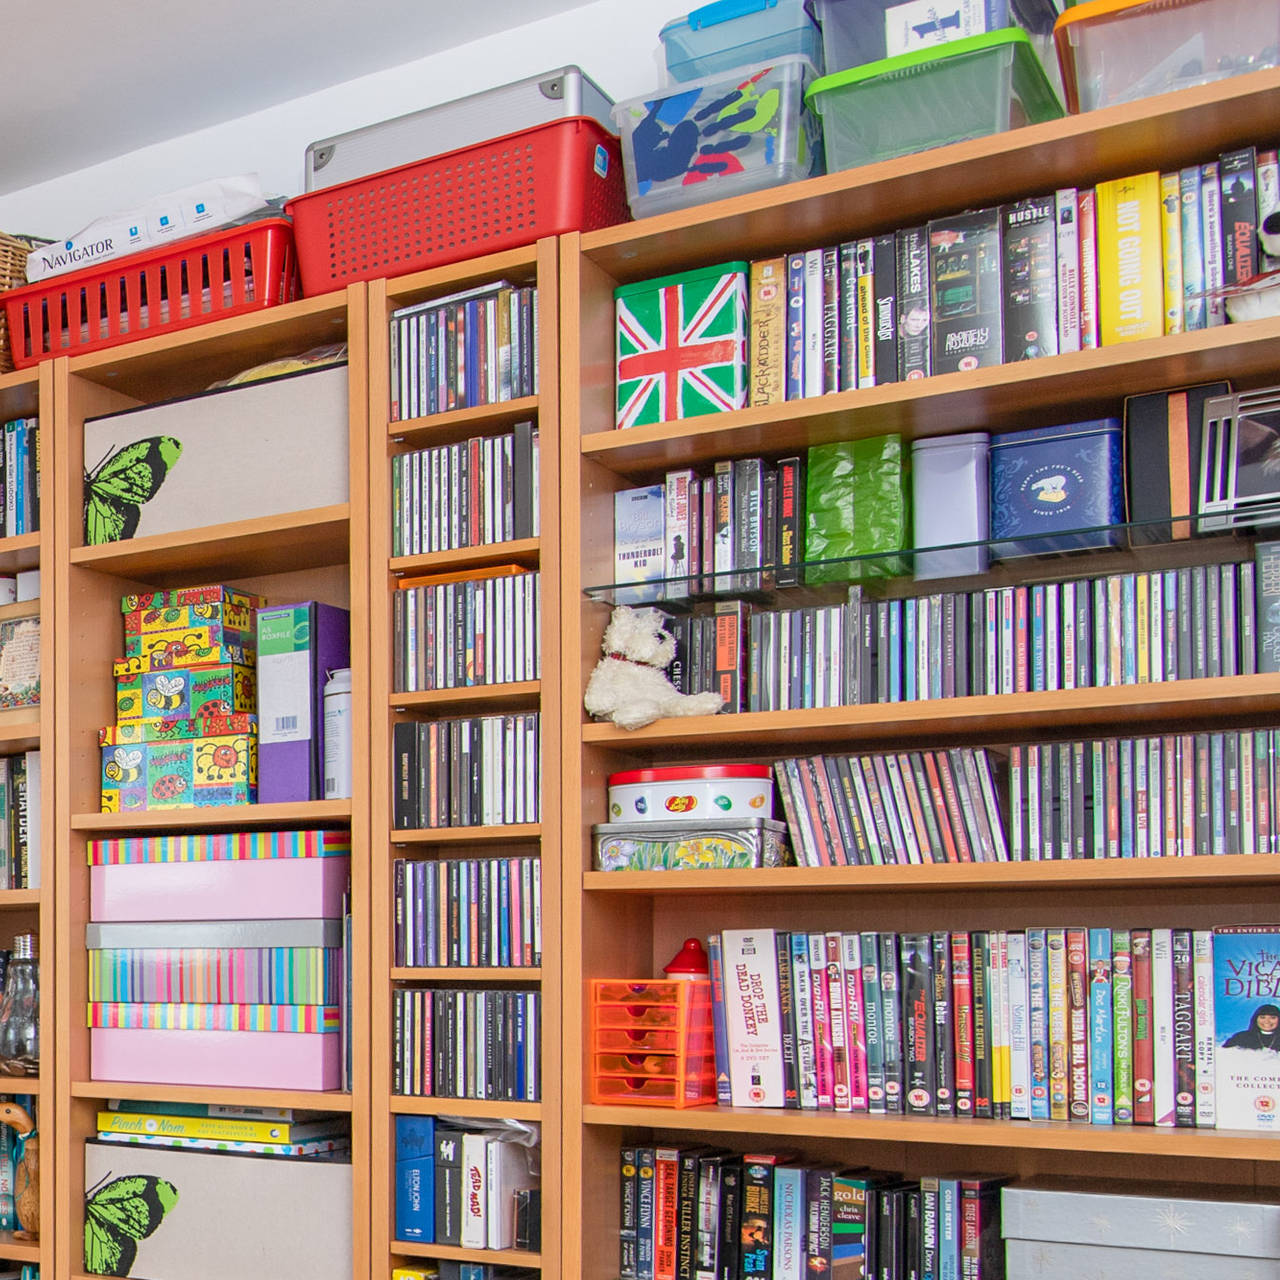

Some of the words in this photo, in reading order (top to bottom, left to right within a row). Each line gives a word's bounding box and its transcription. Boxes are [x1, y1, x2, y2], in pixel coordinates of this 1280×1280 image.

[1008, 206, 1050, 225] HUSTLE
[1117, 200, 1141, 232] NOT
[42, 238, 113, 272] NAVIGATOR
[808, 258, 819, 277] Wii
[1117, 236, 1142, 285] GOING
[1068, 269, 1077, 287] BILLY
[1068, 289, 1077, 329] CONNOLLY
[1120, 289, 1143, 319] OUT
[824, 301, 837, 362] TAGGART
[675, 476, 687, 500] BRIDGET
[749, 490, 759, 511] BILL
[675, 501, 687, 521] JONES
[749, 515, 759, 552] BRYSON
[262, 632, 291, 641] BOXFILE
[1156, 940, 1168, 960] Wii
[736, 963, 750, 992] DEAD
[1030, 952, 1043, 985] MOCK
[1051, 952, 1063, 986] MOCK
[751, 973, 765, 1001] DROP
[758, 1002, 769, 1024] THE
[830, 981, 842, 1008] ROWAN
[1030, 987, 1043, 1008] THE
[1051, 987, 1063, 1008] THE
[1094, 989, 1107, 1006] Doc
[1116, 981, 1131, 1008] RIKKI
[740, 994, 758, 1037] DONKEY
[867, 1001, 879, 1044] monroe
[884, 997, 896, 1041] monroe
[936, 1000, 947, 1024] Rebus
[1012, 1003, 1025, 1035] Notting
[1030, 1010, 1043, 1042] WEEK
[1051, 1010, 1063, 1042] WEEK
[1073, 1009, 1085, 1041] WEEK
[1094, 1007, 1109, 1043] Martin
[831, 1010, 844, 1047] ATKINSON
[914, 1000, 926, 1062] EQUALIZER
[1115, 1007, 1131, 1058] FULTON'S
[1176, 991, 1193, 1062] TAGGART
[783, 1032, 794, 1064] DECEIT
[1012, 1036, 1025, 1051] Hill
[1073, 1042, 1085, 1065] THE
[1073, 1066, 1086, 1101] MOCK
[110, 1117, 143, 1131] Pinch
[157, 1121, 185, 1134] Nom
[0, 1153, 10, 1175] TELL
[0, 1177, 9, 1192] NO
[413, 1168, 422, 1192] ELTON
[640, 1179, 651, 1200] VINCE
[820, 1177, 831, 1197] JACK
[0, 1194, 10, 1216] LIES
[413, 1193, 422, 1211] JOHN
[746, 1185, 759, 1213] BURKE
[784, 1183, 794, 1230] NICHOLAS
[833, 1188, 865, 1201] gold
[925, 1192, 935, 1209] IAN
[944, 1188, 952, 1211] COLIN
[640, 1201, 651, 1228] FLYNN
[682, 1200, 692, 1232] KILLER
[820, 1199, 830, 1249] HENDERSON
[944, 1212, 953, 1240] DEXTER
[925, 1210, 936, 1248] RANKIN
[680, 1233, 691, 1277] INSTINCT
[743, 1253, 757, 1272] Peak
[754, 1249, 769, 1272] Swan
[783, 1231, 794, 1271] PARSONS
[925, 1249, 934, 1272] Doors
